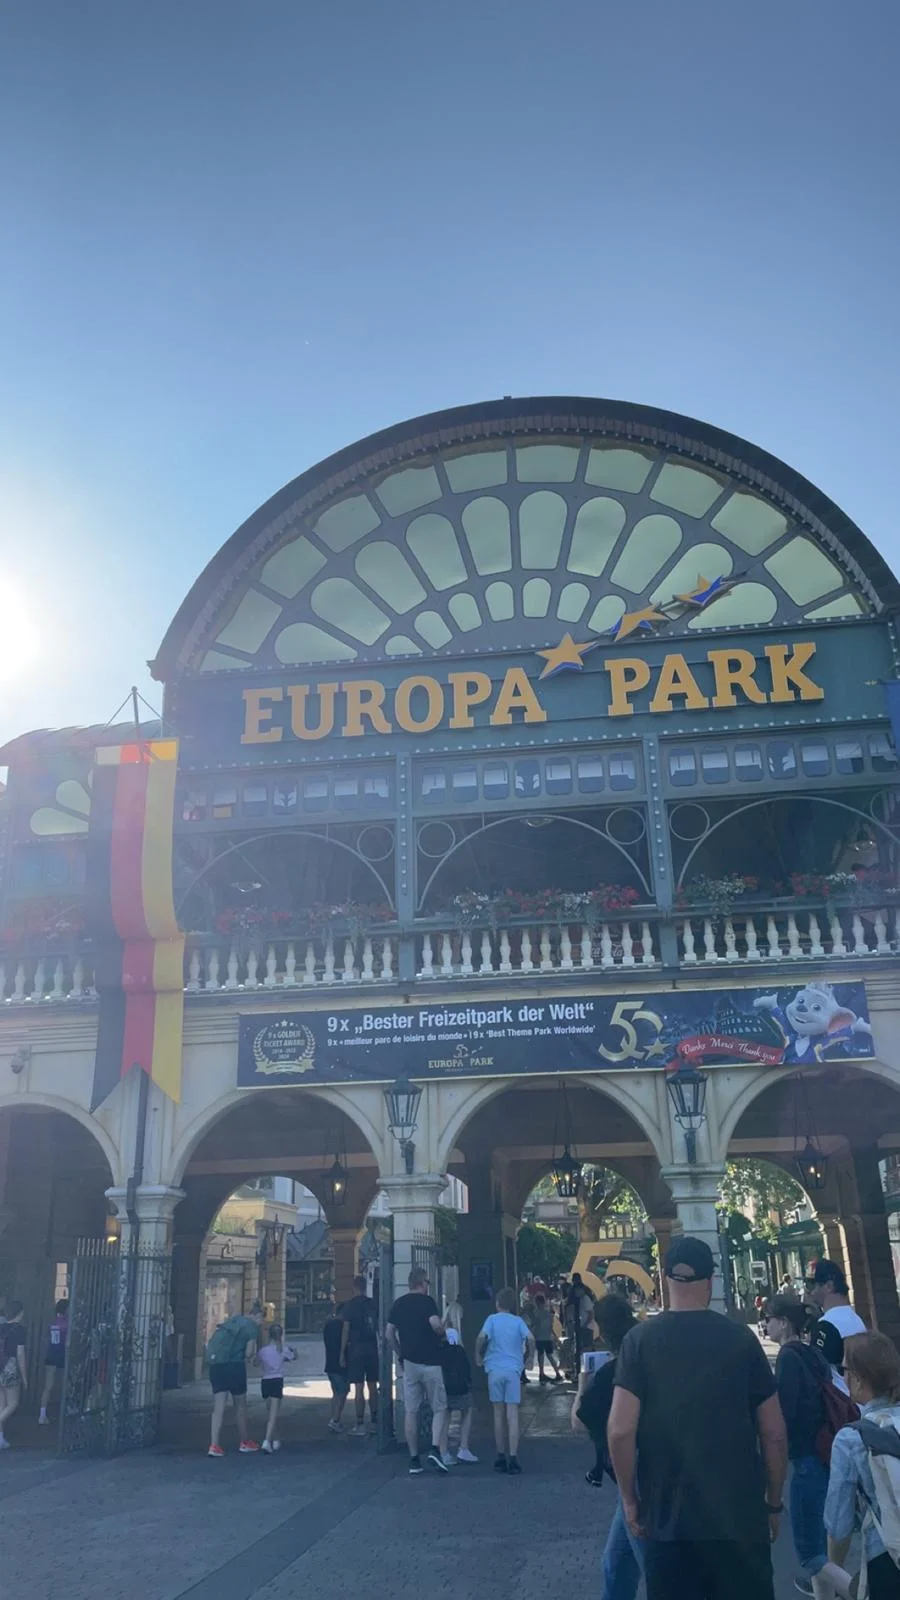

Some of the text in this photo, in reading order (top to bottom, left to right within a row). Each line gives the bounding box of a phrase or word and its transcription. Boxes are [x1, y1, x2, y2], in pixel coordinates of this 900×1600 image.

[240, 642, 825, 745] EUROPA PARK
[419, 1006, 514, 1028] Freizeitpark
[518, 1004, 545, 1022] der
[374, 1035, 391, 1046] parc
[392, 1034, 402, 1043] de
[403, 1033, 425, 1043] loisirs
[426, 1032, 436, 1041] du
[508, 1027, 532, 1037] Theme
[534, 1026, 552, 1036] Park
[710, 1037, 734, 1049] Merci
[738, 1043, 760, 1057] Thank
[428, 1056, 494, 1069] EUROPA PARK
